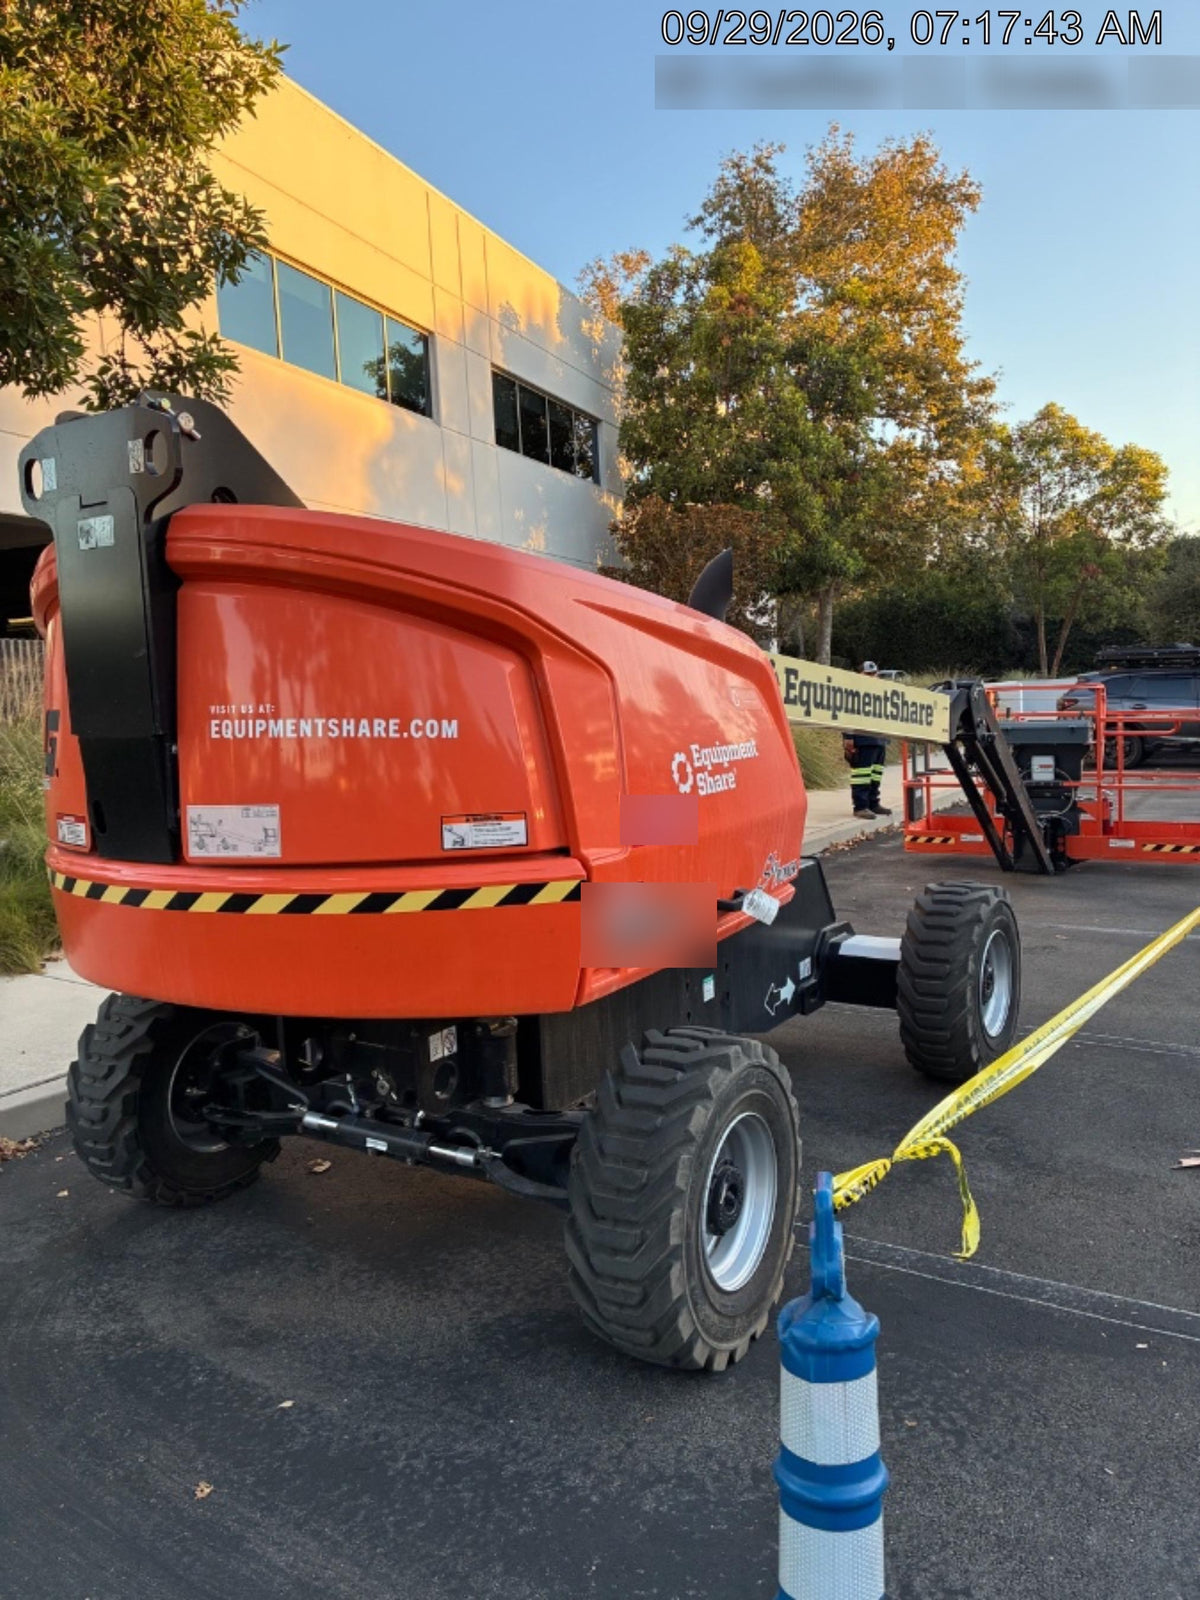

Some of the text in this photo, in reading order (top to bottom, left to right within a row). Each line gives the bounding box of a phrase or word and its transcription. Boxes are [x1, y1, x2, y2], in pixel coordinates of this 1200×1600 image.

[209, 703, 276, 715] VISIT US AT:
[783, 666, 934, 727] EquipmentShare
[210, 718, 459, 740] EQUIPMENTSHARE.COM
[690, 740, 759, 771] Equipment
[696, 770, 737, 796] Share
